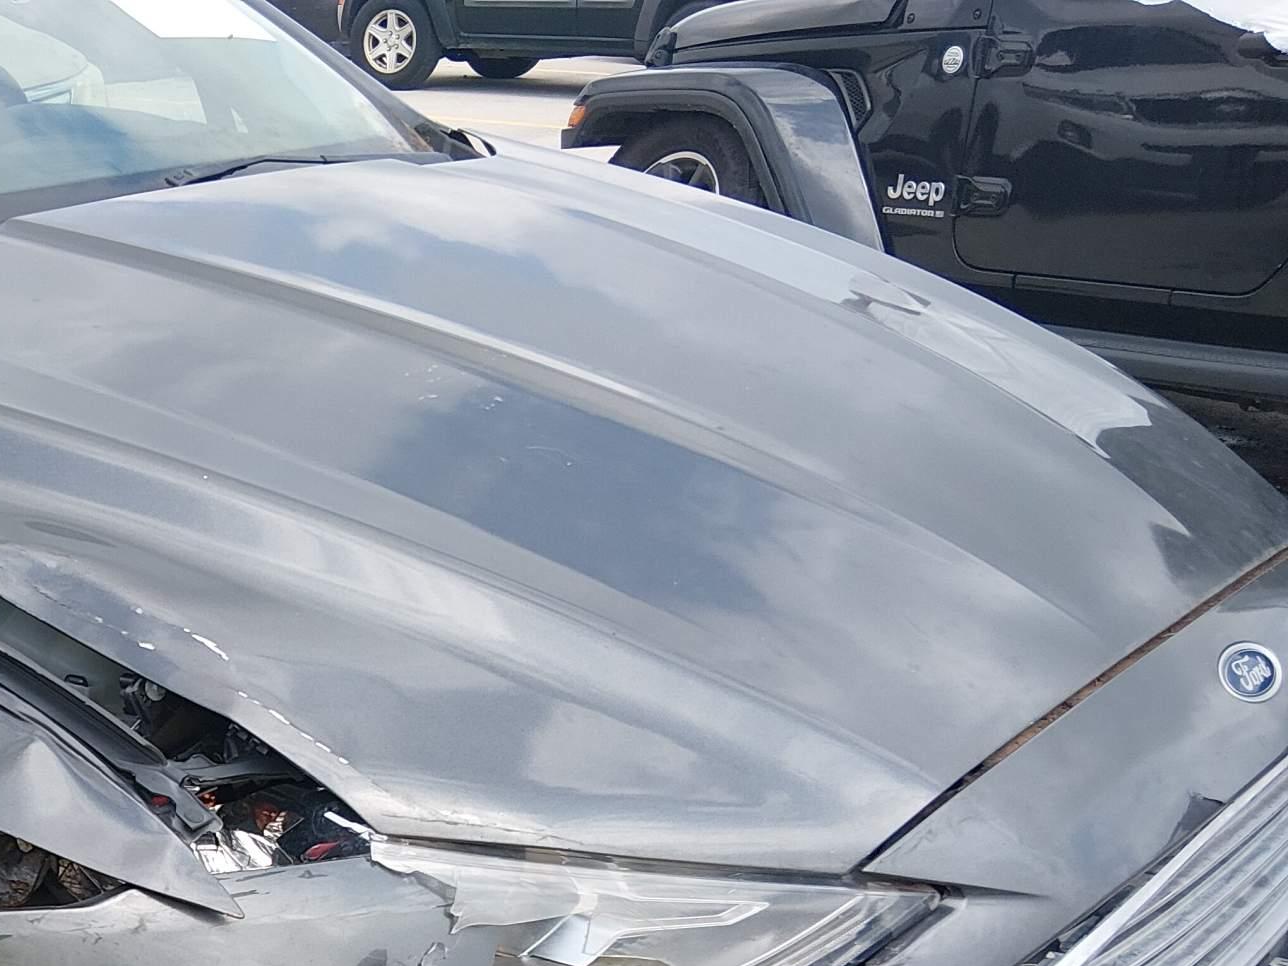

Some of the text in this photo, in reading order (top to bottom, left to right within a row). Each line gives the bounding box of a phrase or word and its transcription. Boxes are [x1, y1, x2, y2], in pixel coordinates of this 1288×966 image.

[887, 174, 945, 207] Jeep
[882, 206, 934, 217] GLADIATOR
[1231, 655, 1272, 691] Ford
